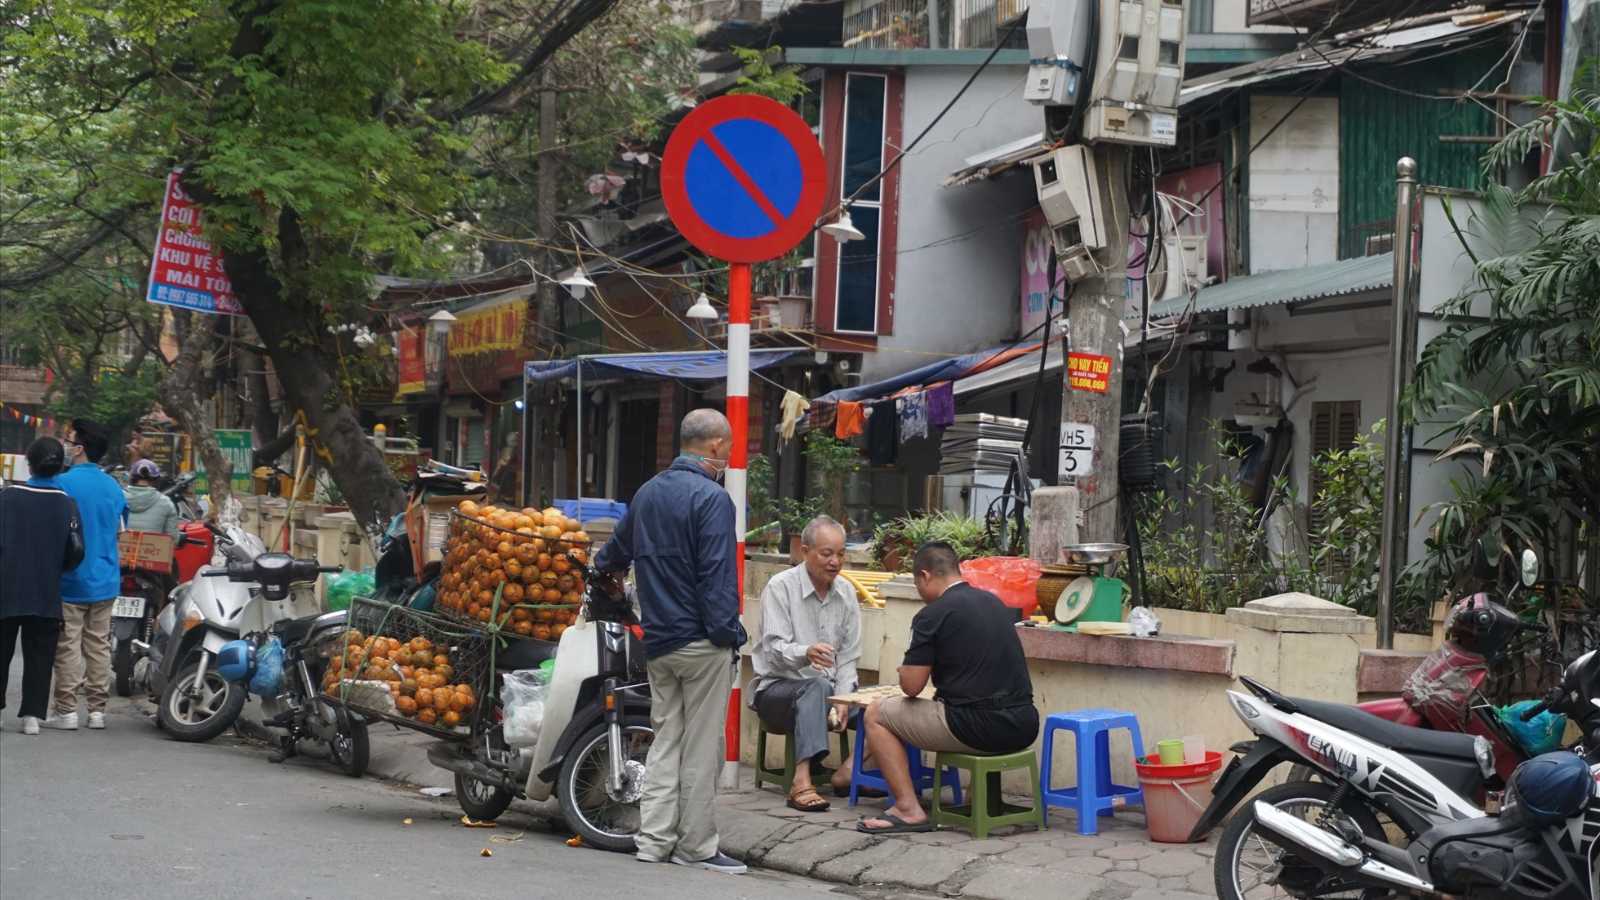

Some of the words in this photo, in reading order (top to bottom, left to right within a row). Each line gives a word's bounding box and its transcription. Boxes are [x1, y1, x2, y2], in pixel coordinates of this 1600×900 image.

[159, 247, 190, 266] KHU
[1079, 358, 1092, 372] VAY
[1065, 451, 1077, 472] 3
